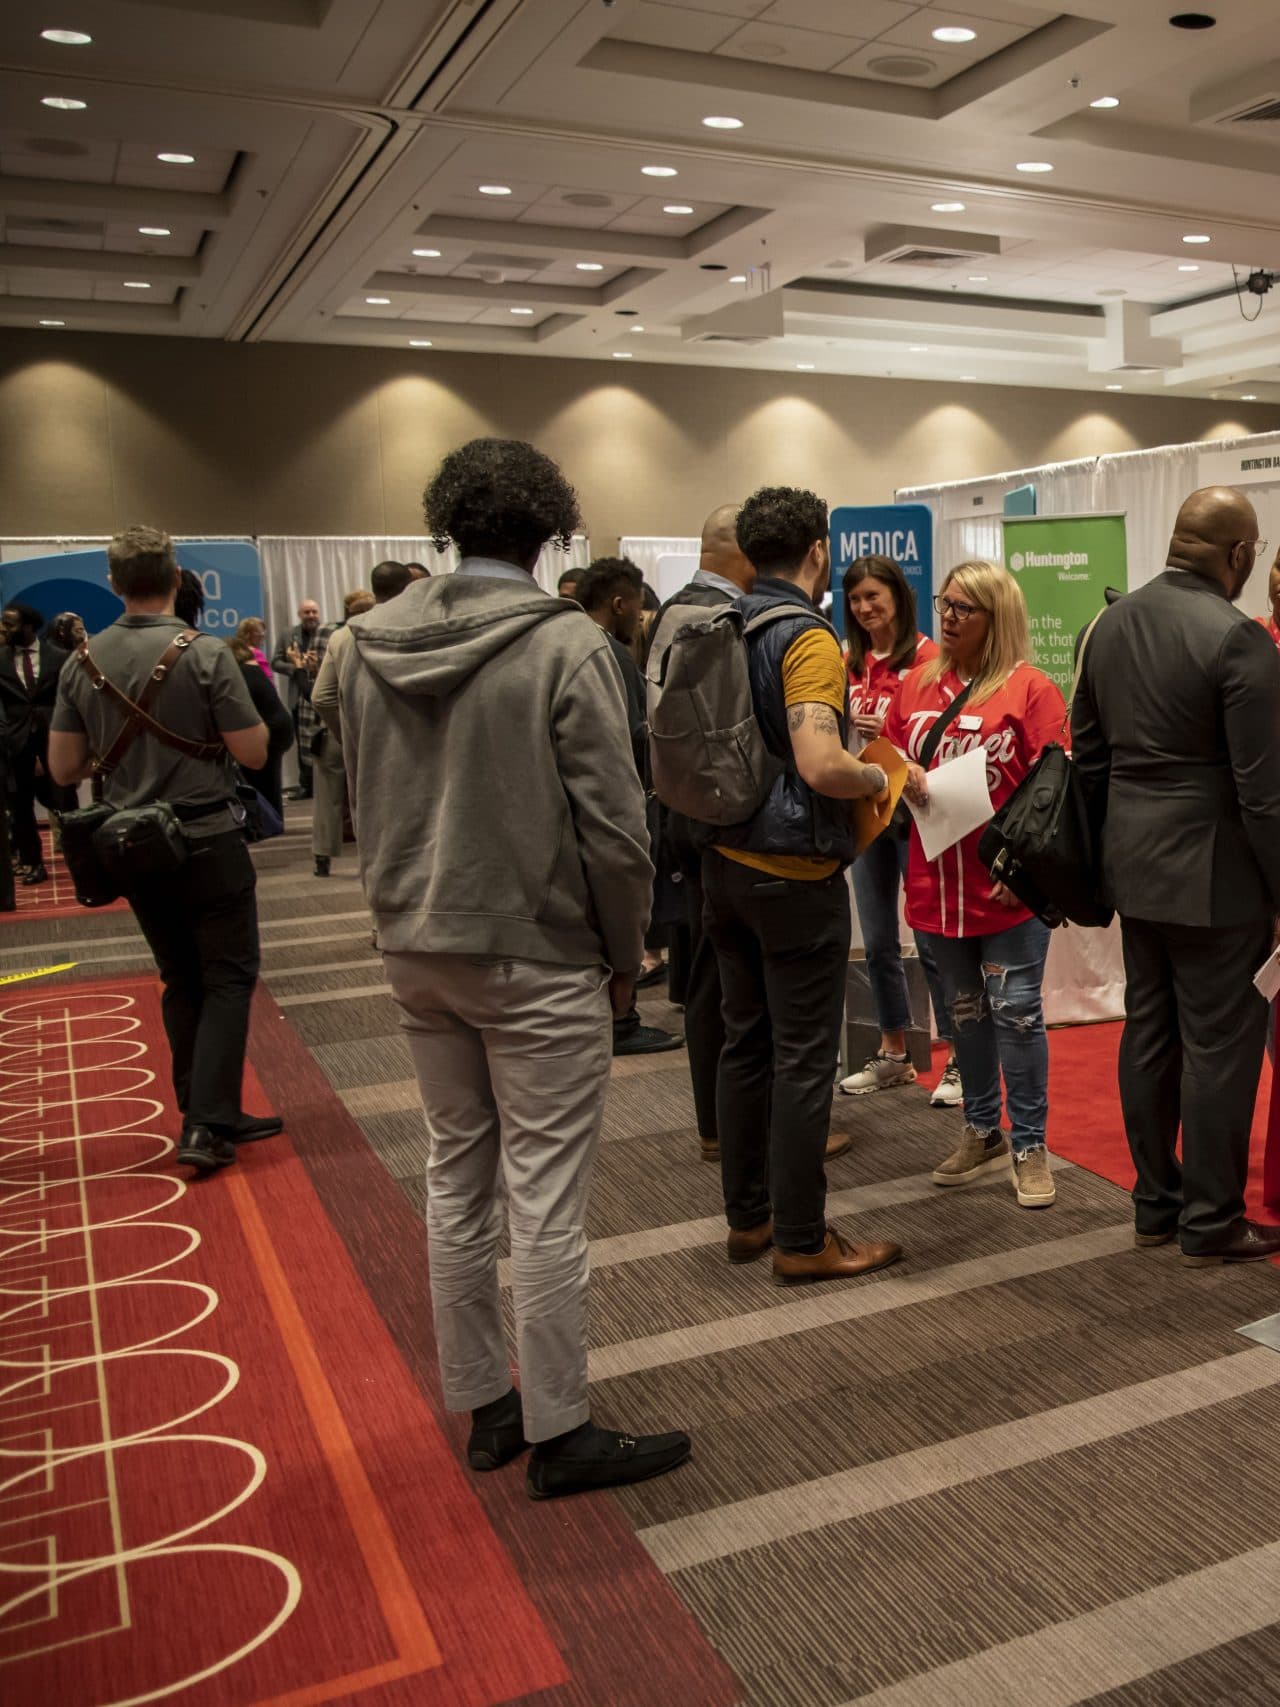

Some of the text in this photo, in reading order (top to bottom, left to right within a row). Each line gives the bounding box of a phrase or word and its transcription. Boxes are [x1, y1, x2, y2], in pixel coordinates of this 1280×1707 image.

[840, 530, 919, 563] MEDICA
[1025, 551, 1089, 570] Huntington
[1041, 613, 1062, 629] the
[1048, 631, 1074, 647] that
[1051, 651, 1072, 665] out
